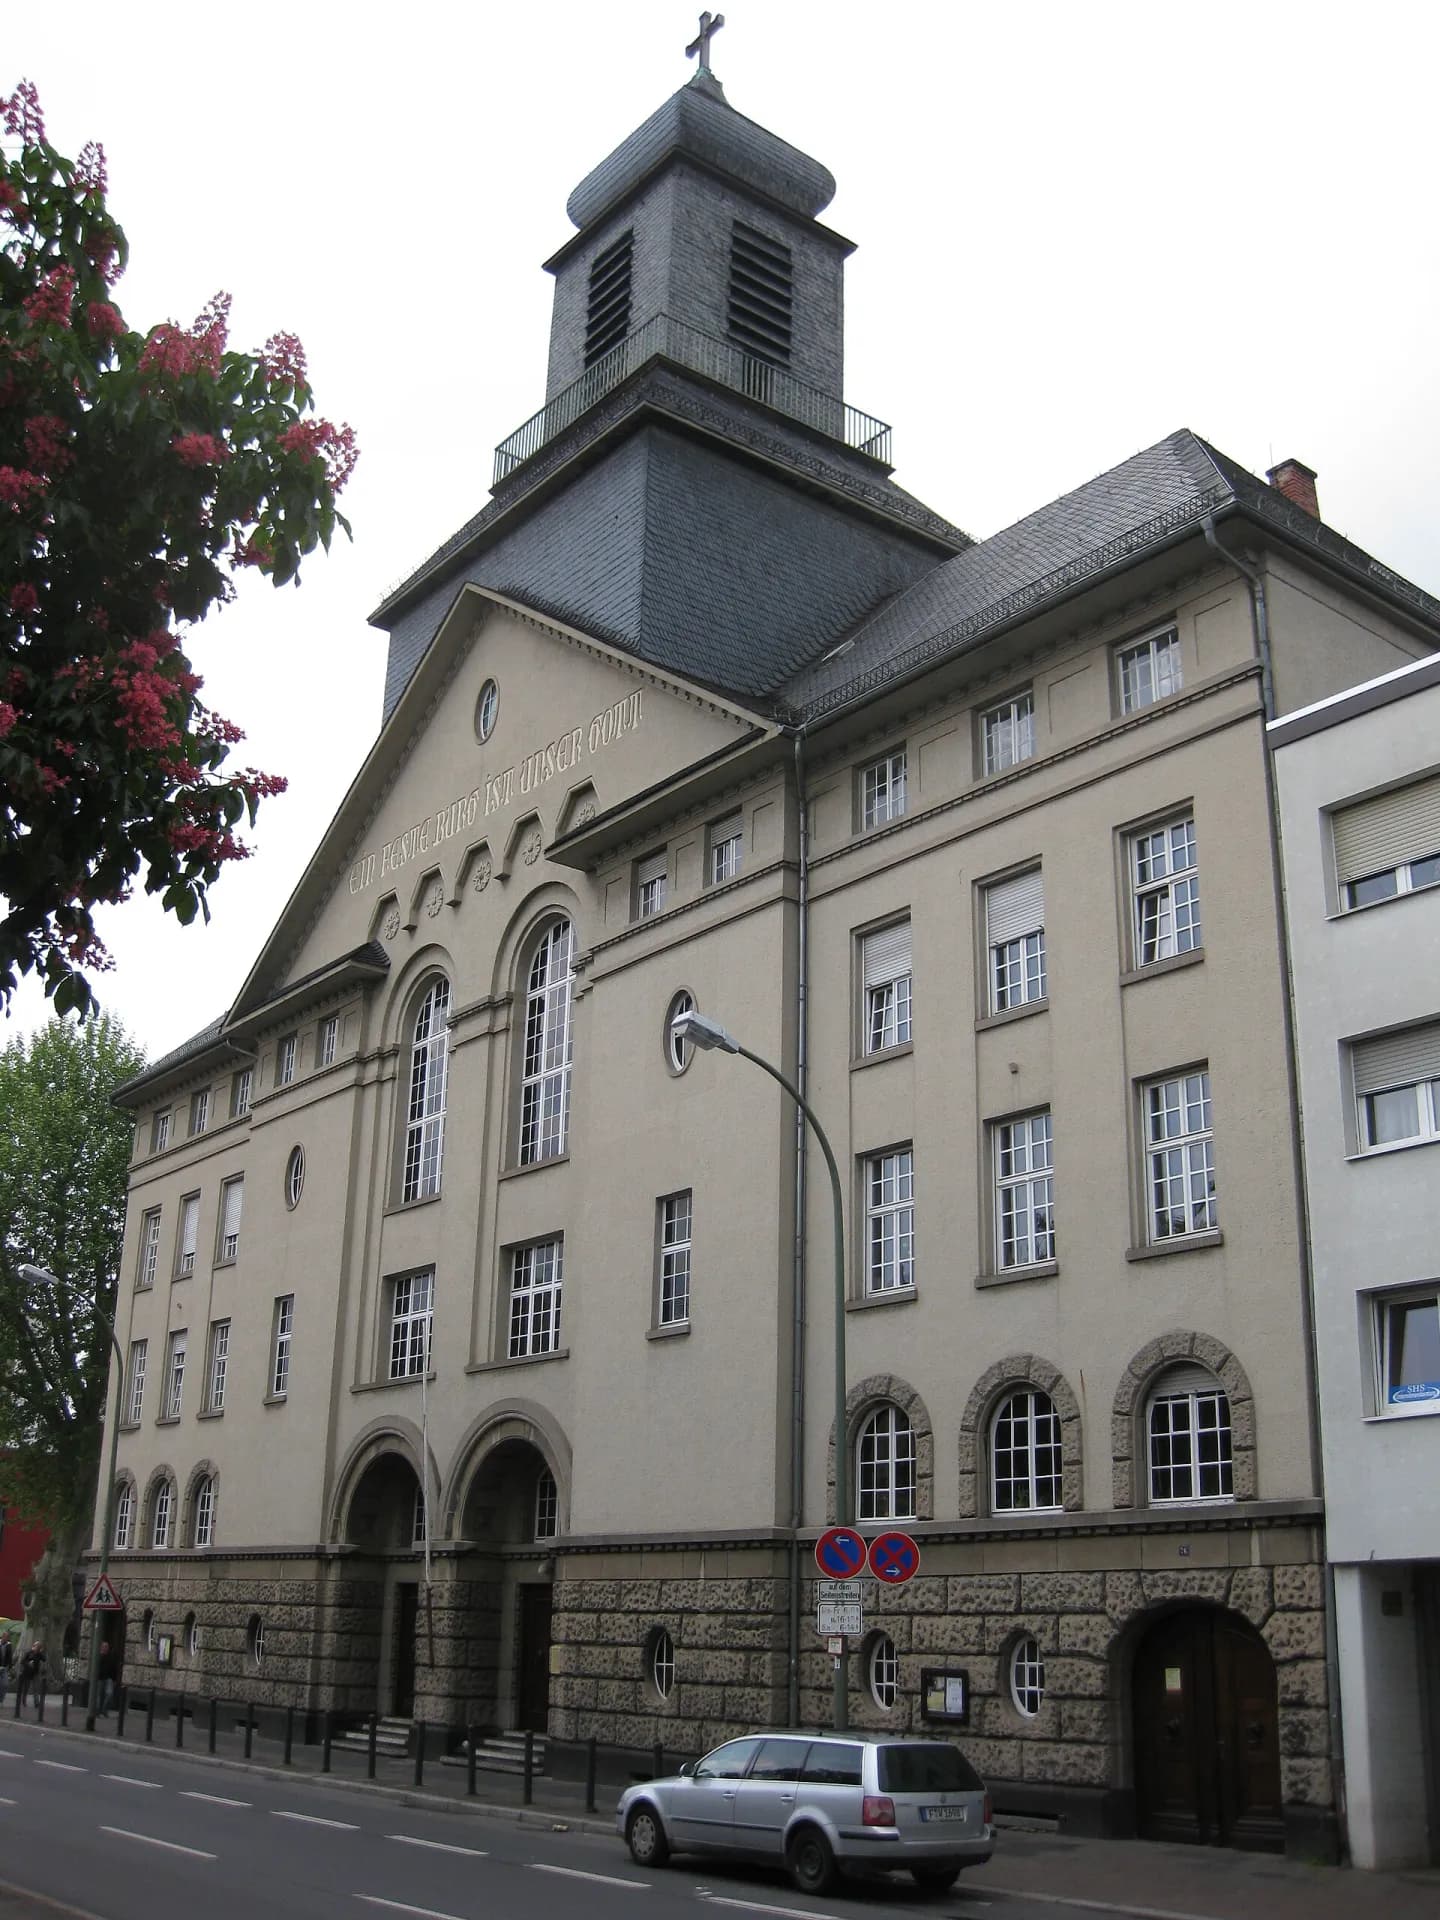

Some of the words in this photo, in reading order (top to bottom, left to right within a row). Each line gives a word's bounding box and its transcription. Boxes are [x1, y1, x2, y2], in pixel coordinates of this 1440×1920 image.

[350, 853, 375, 894] EIN
[380, 817, 432, 878] FESTE
[432, 787, 480, 846] BURG
[483, 766, 515, 817] IST
[520, 727, 583, 794] UNSER
[588, 687, 643, 755] GOTT
[1407, 1384, 1425, 1393] SHS
[829, 1583, 838, 1591] auf
[839, 1583, 851, 1591] dem
